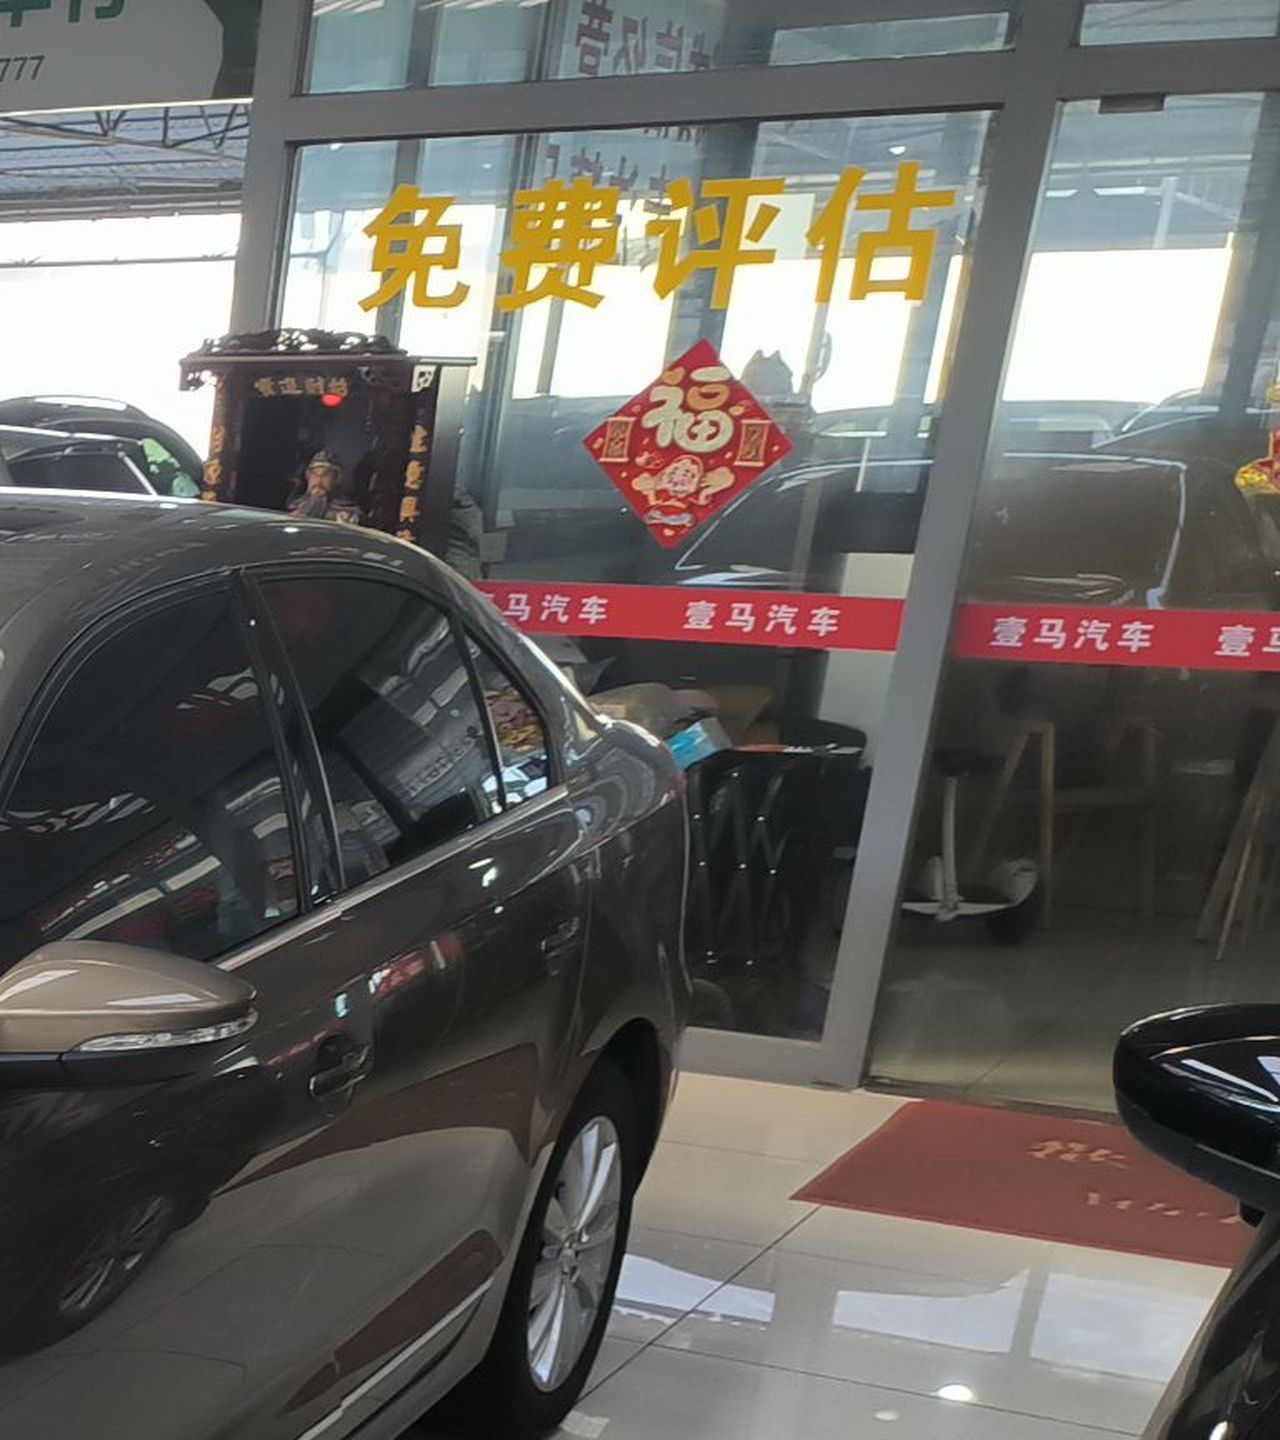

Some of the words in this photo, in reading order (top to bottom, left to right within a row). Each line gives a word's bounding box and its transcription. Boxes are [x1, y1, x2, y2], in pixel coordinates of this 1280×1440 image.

[358, 160, 956, 312] 免费评估
[642, 366, 735, 454] 福
[483, 592, 609, 624] 马汽车
[683, 600, 841, 637] 壹马汽车
[990, 616, 1155, 653] 壹马汽车
